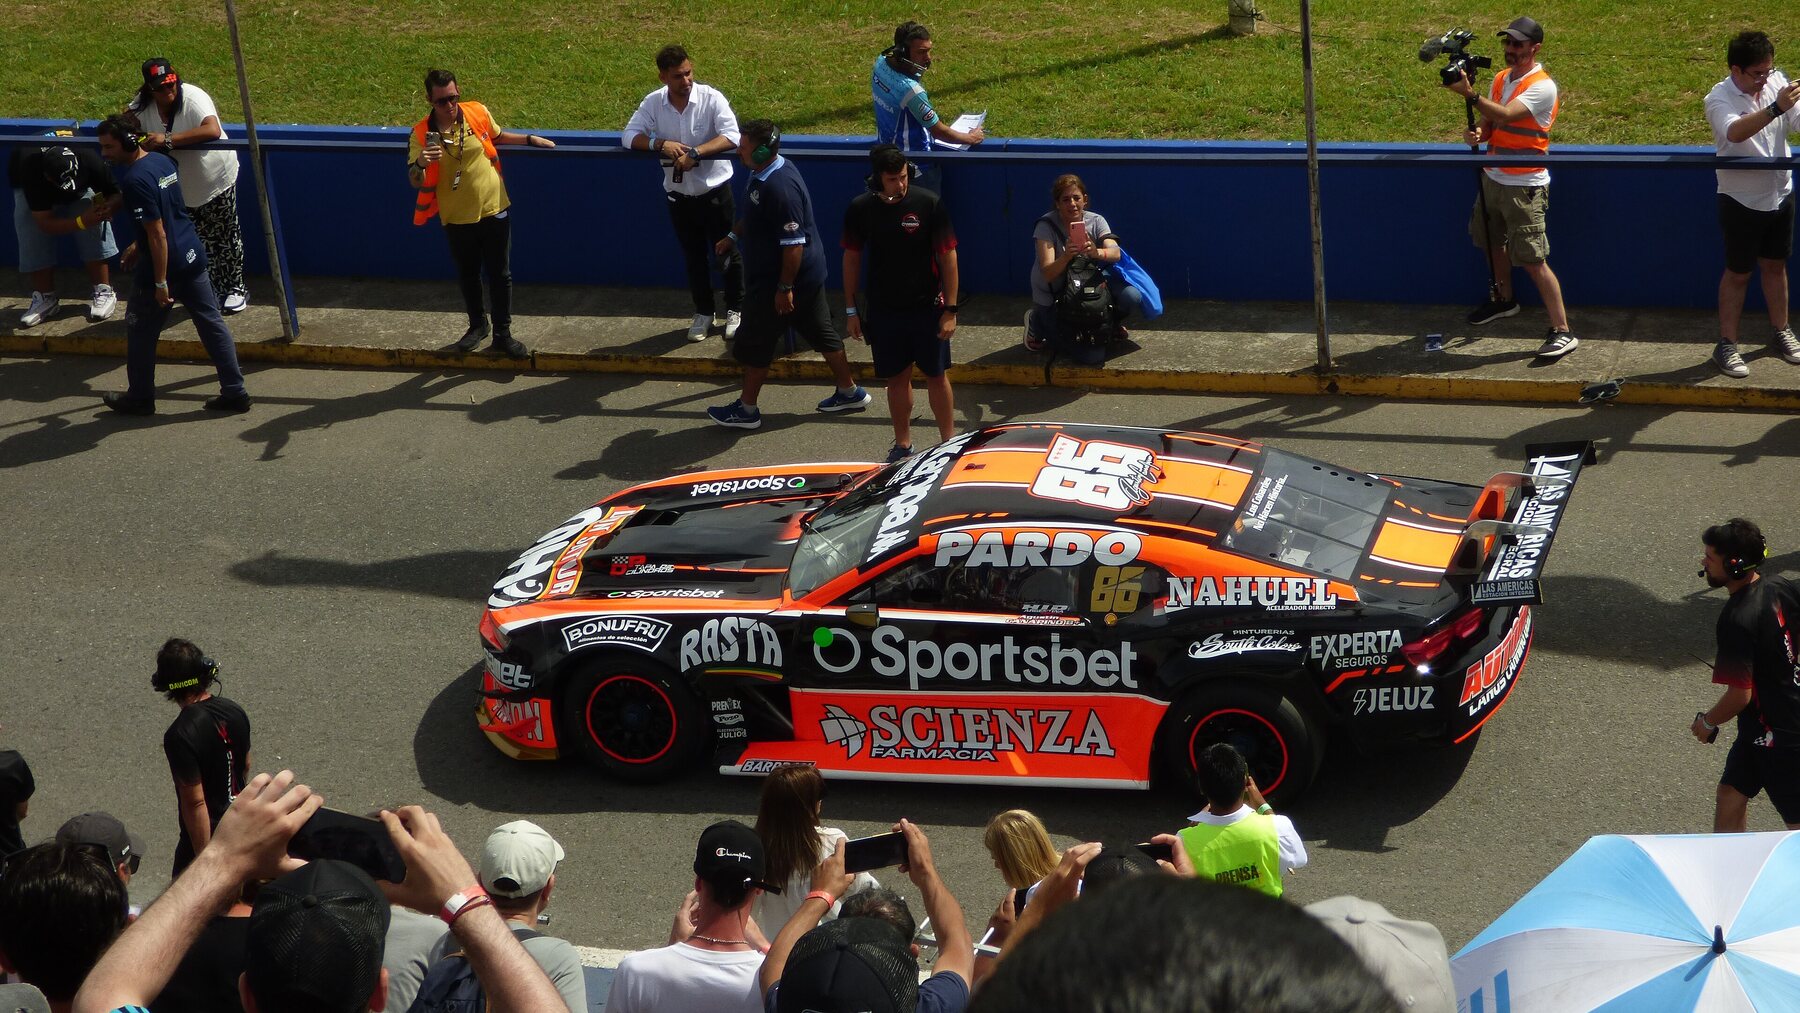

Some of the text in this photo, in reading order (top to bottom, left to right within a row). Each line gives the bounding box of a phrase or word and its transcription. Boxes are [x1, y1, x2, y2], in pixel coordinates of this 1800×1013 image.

[690, 475, 786, 497] Sportsbet
[1032, 436, 1152, 509] 86
[1246, 477, 1272, 517] Los Cobardes
[1258, 500, 1275, 521] Hacen
[1253, 520, 1265, 532] No
[935, 532, 1142, 568] PARDO
[626, 588, 725, 599] Sportsbet
[1090, 566, 1146, 612] 86
[1166, 577, 1338, 606] NAHUEL
[1481, 580, 1534, 593] LAS AMERICAS
[568, 619, 665, 642] BONUFRU
[680, 616, 783, 673] RASTA
[871, 626, 1138, 690] Sportsbet
[1310, 629, 1403, 671] EXPERTA
[1335, 655, 1388, 669] SEGUROS
[168, 677, 199, 690] DAVICOM
[1367, 686, 1435, 713] JELUZ
[870, 704, 1116, 756] SCIENZA
[870, 748, 996, 761] FARMACIA
